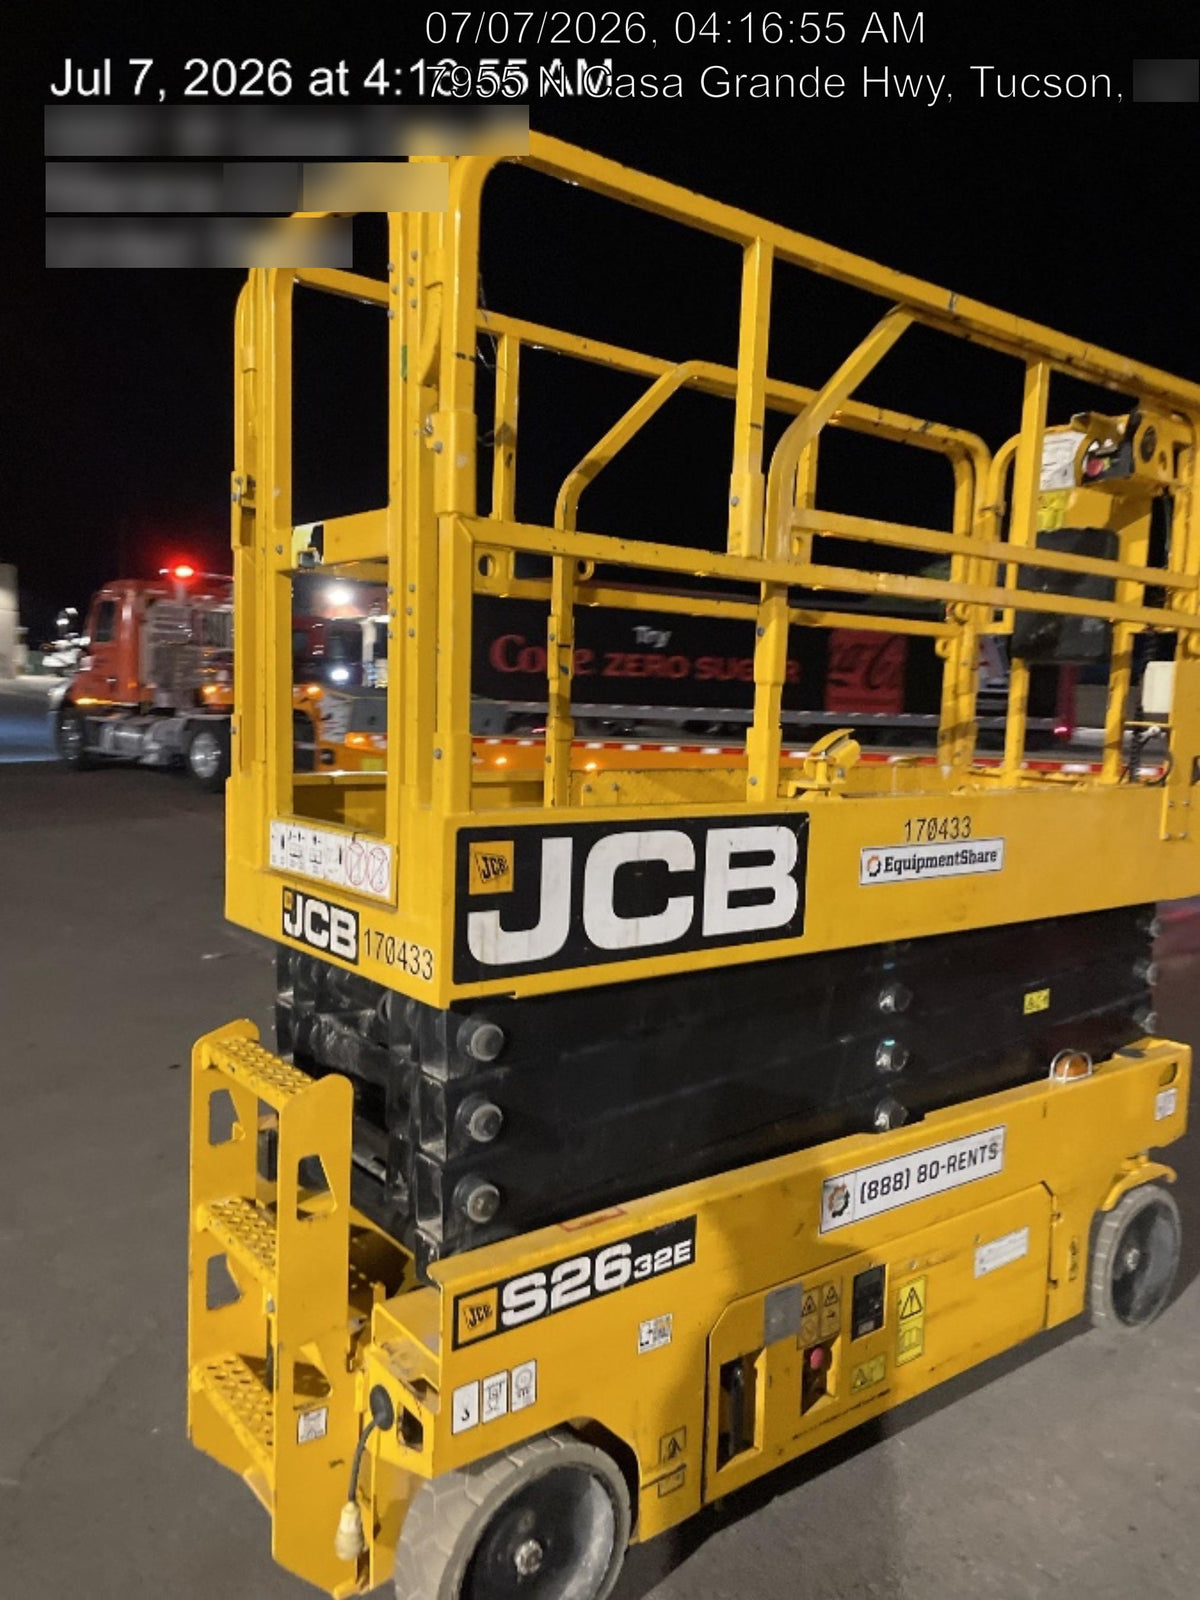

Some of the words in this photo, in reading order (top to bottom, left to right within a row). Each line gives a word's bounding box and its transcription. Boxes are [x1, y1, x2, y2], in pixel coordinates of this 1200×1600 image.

[489, 633, 597, 675] Coe
[603, 652, 692, 680] ZERO
[693, 654, 801, 682] SUGR
[904, 815, 972, 842] 170433
[883, 849, 998, 876] EquipmentShare
[466, 825, 799, 966] JCB
[283, 893, 357, 960] JCB
[363, 928, 434, 981] 170433
[860, 1168, 911, 1204] (888)
[916, 1141, 999, 1184] 80-RENTS
